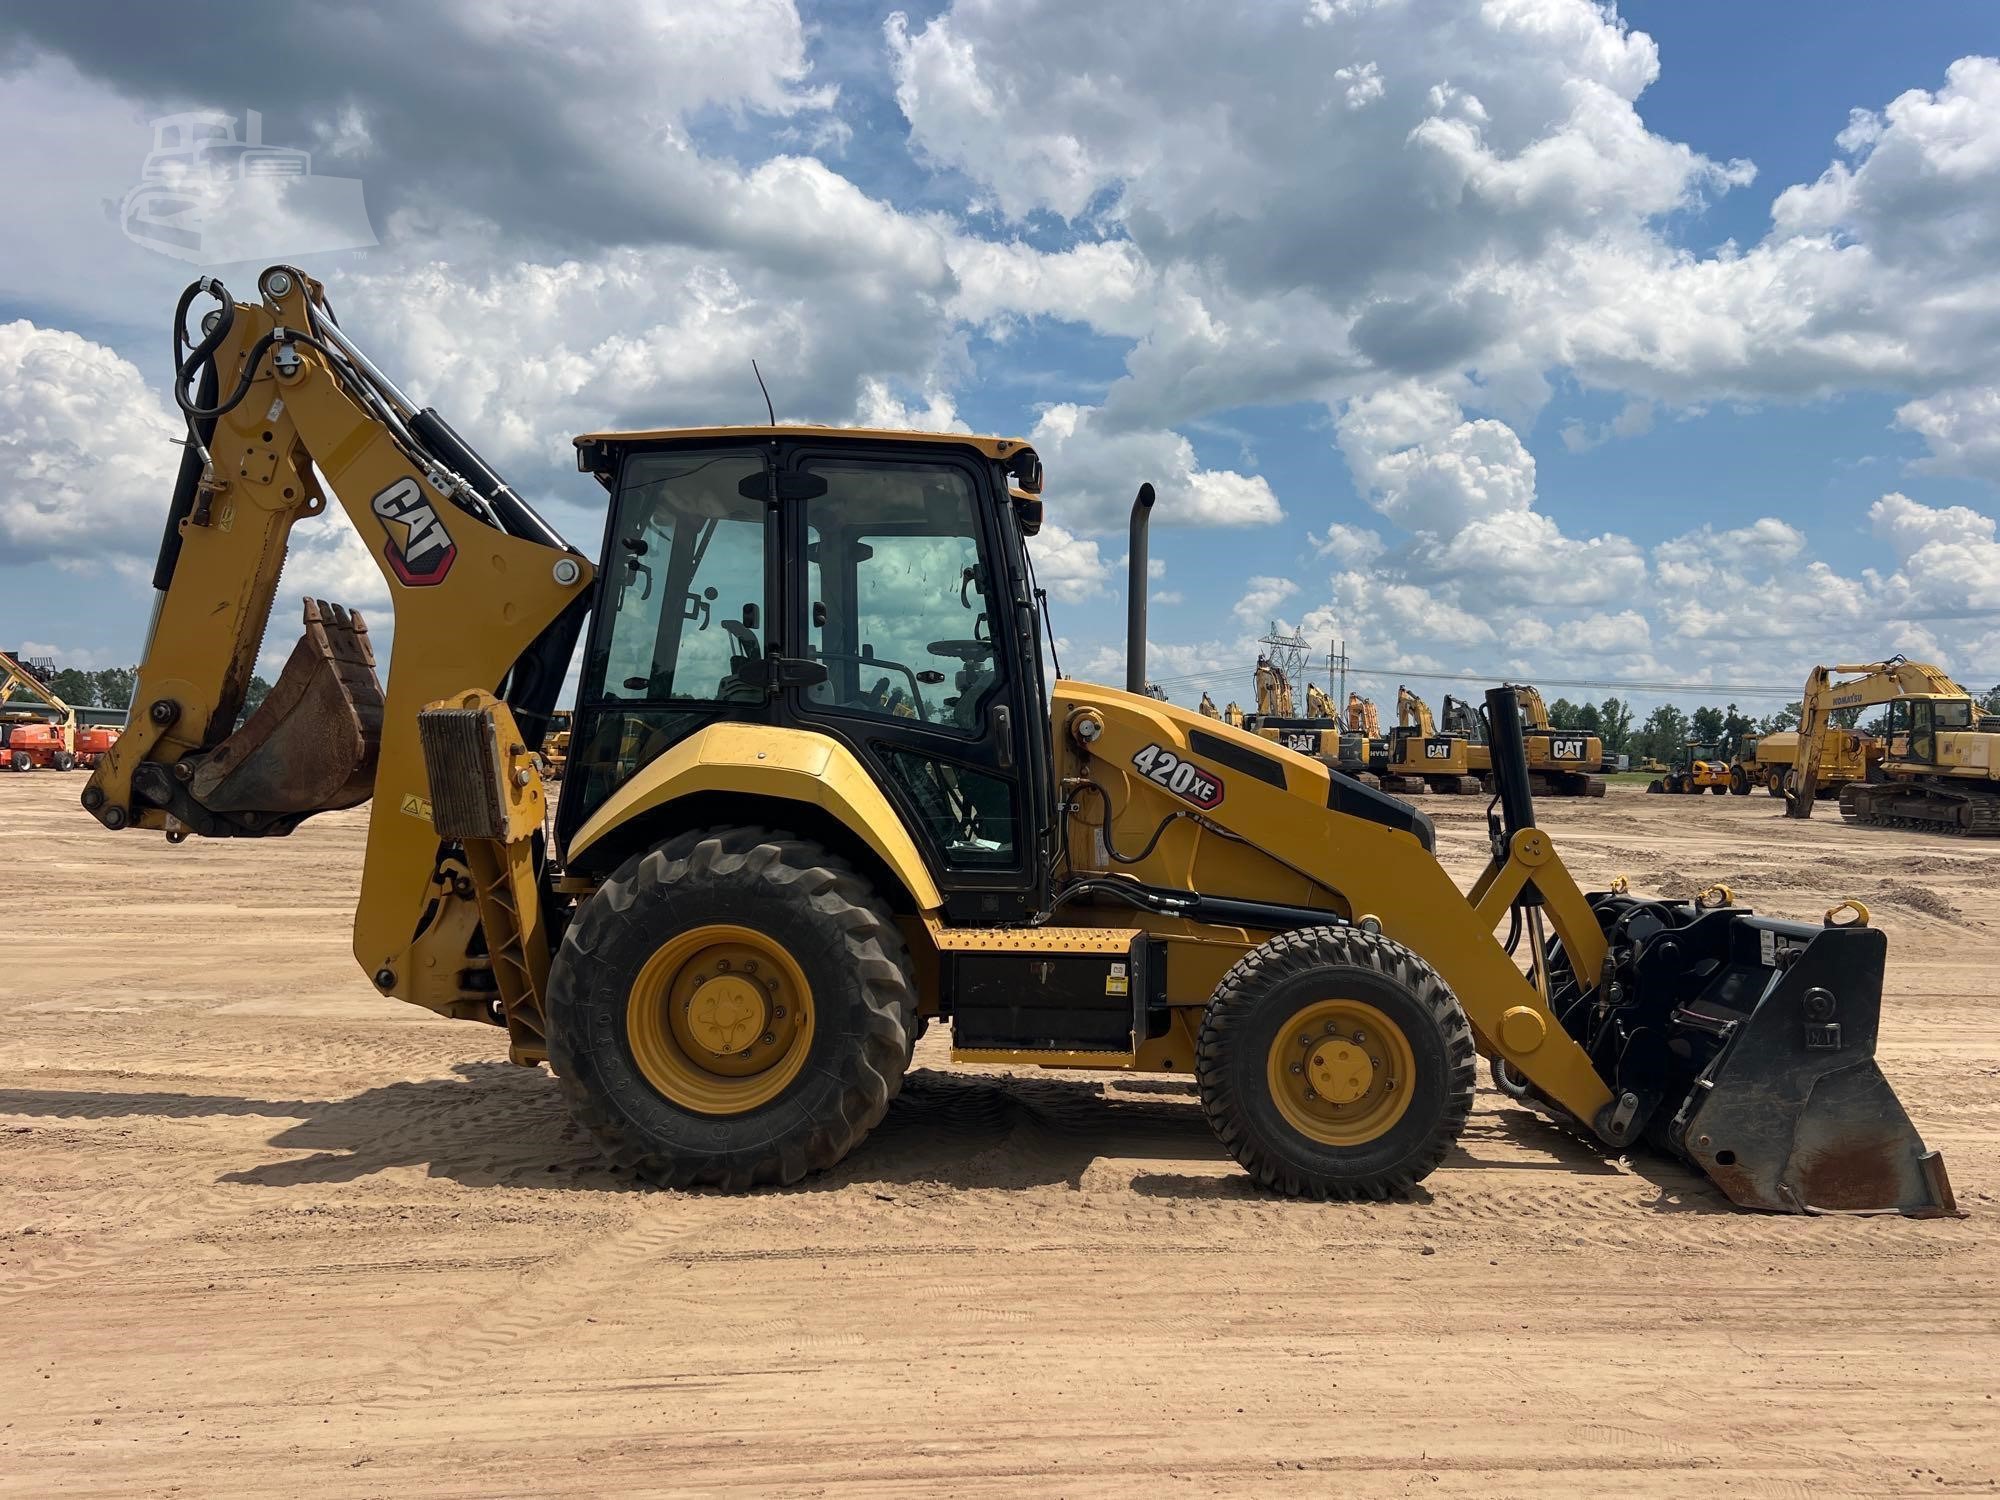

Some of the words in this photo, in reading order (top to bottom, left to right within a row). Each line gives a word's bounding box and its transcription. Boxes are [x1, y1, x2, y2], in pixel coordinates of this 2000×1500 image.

[373, 478, 451, 563] CAT
[1833, 694, 1862, 705] KOMATSU
[1288, 734, 1315, 750] CAT
[1553, 740, 1583, 758] CAT
[1427, 744, 1449, 758] CAT
